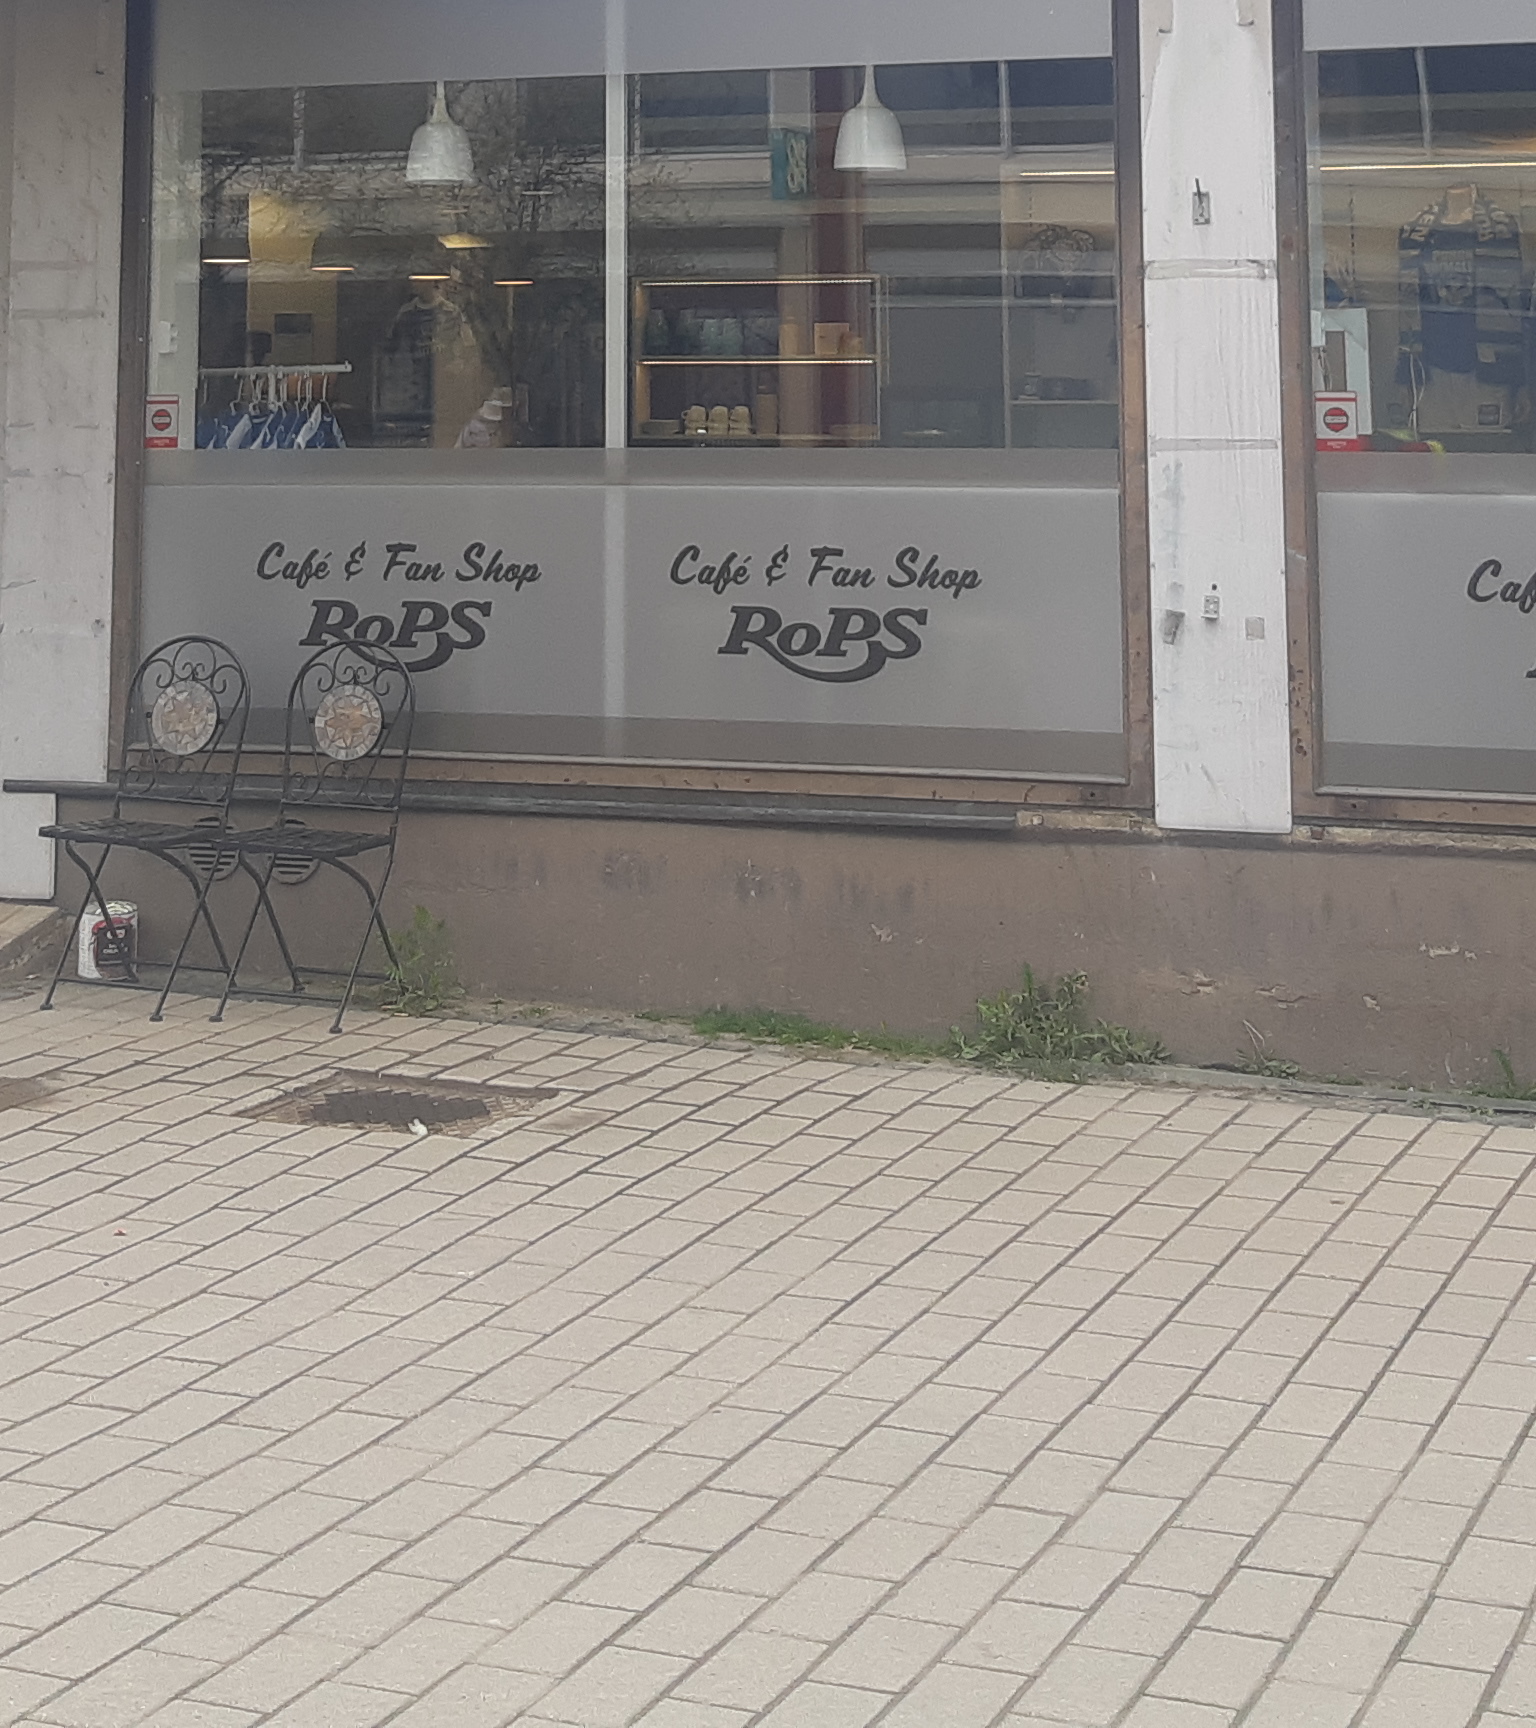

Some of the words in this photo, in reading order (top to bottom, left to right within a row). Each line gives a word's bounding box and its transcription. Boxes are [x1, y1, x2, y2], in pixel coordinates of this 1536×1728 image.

[256, 541, 332, 584] Café
[383, 542, 445, 584] Fan
[455, 543, 542, 590] Shop
[670, 545, 752, 591] Café
[809, 546, 874, 591] Fan
[888, 545, 982, 596] Shop
[298, 599, 493, 672] RoPS
[717, 605, 928, 684] RoPS
